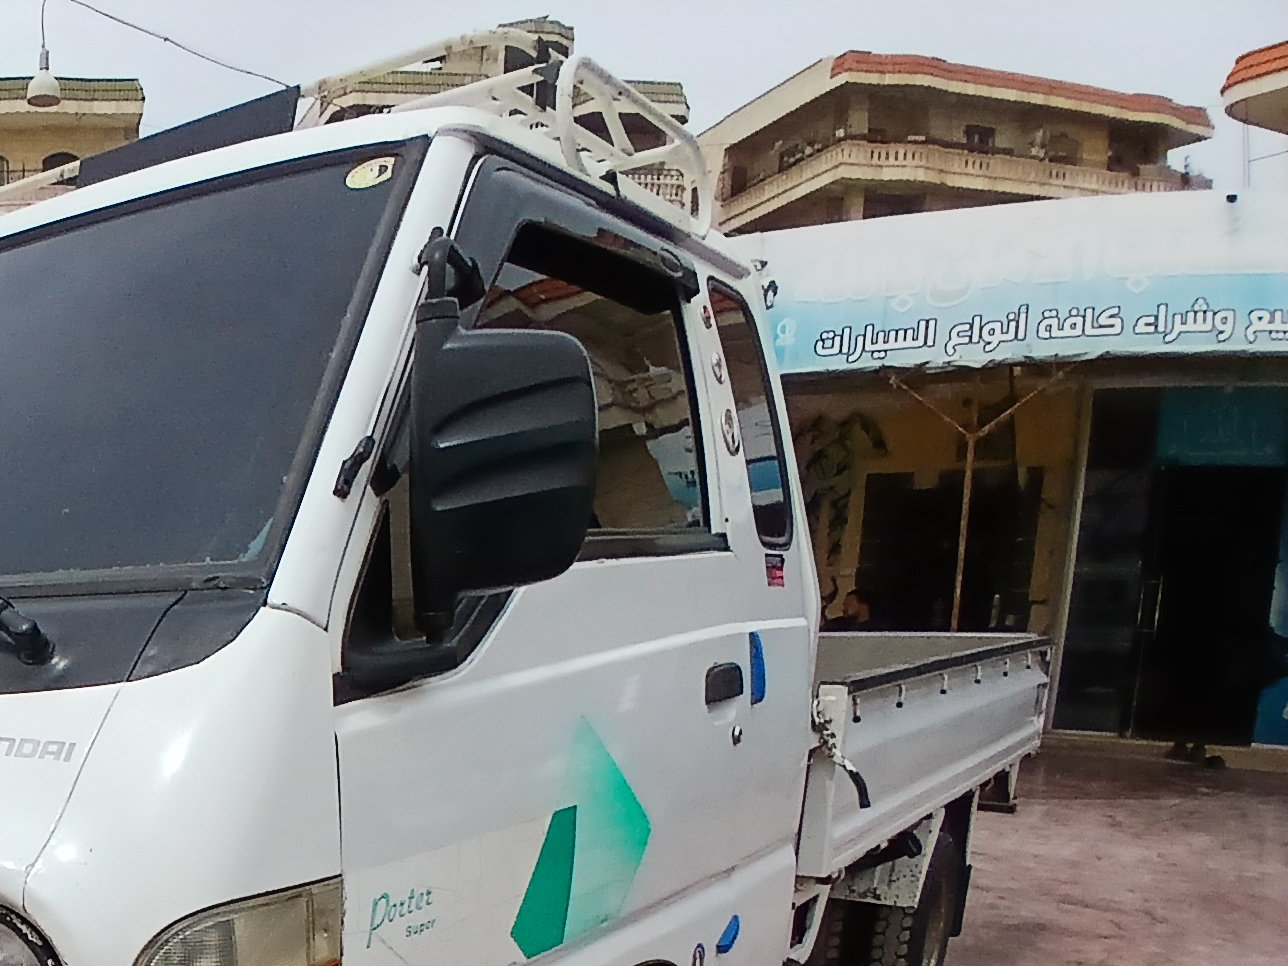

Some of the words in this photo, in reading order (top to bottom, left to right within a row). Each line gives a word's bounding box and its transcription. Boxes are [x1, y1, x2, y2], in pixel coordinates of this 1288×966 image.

[813, 317, 938, 363] السيارات
[944, 303, 1030, 357] أنواع
[1036, 305, 1124, 341] كافة
[1133, 297, 1236, 344] وشراء
